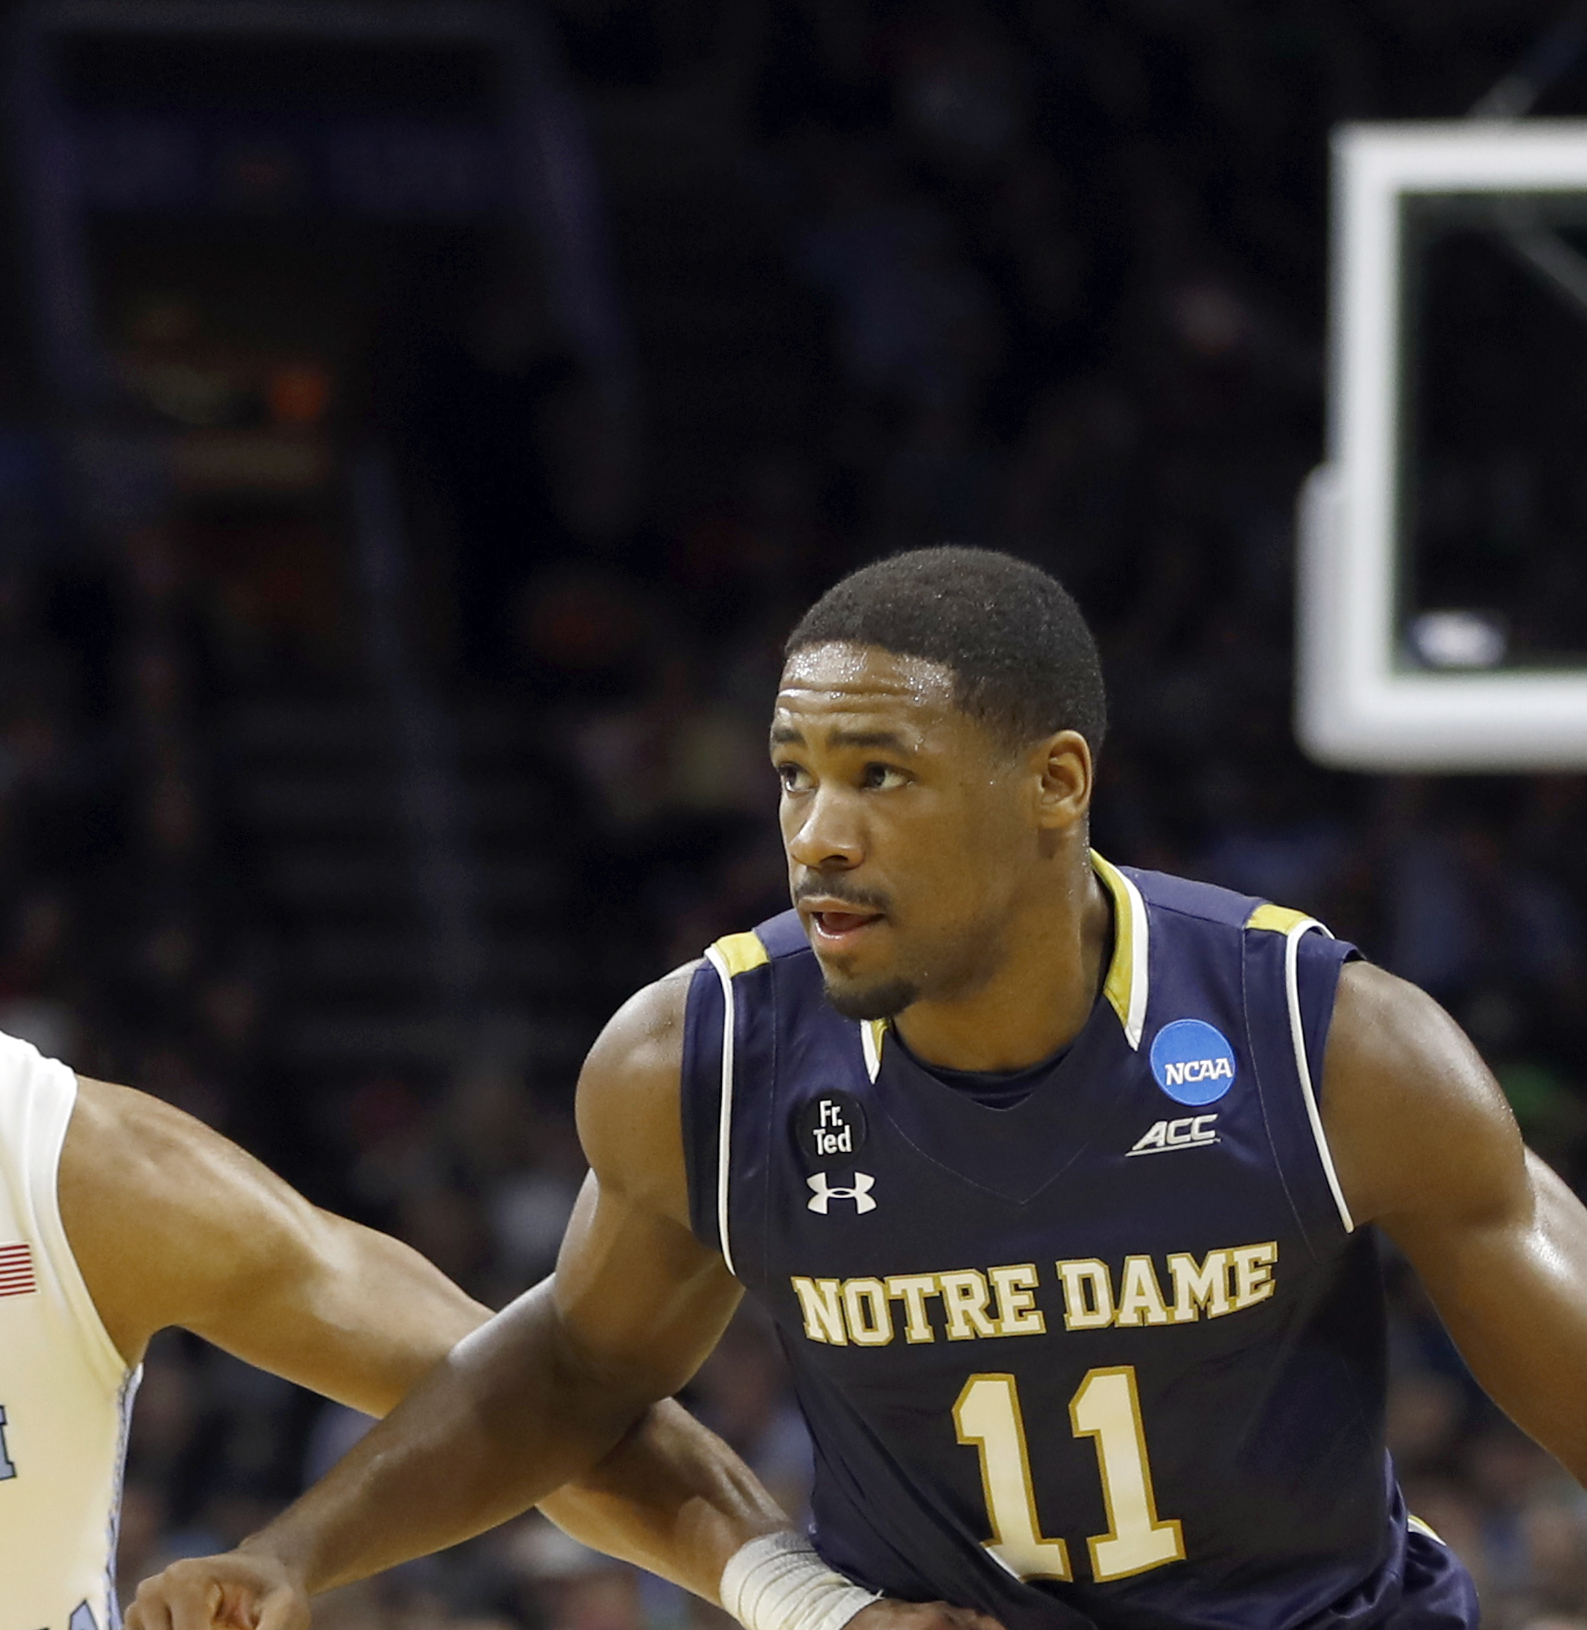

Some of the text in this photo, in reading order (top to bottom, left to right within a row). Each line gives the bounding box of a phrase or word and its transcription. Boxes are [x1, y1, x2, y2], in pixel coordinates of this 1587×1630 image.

[1164, 1057, 1234, 1086] NCAA
[819, 1099, 844, 1128] Fr.
[812, 1124, 853, 1156] Ted
[1131, 1113, 1219, 1151] ACC
[790, 1241, 1278, 1347] NOTRE DAME
[951, 1365, 1186, 1583] 11
